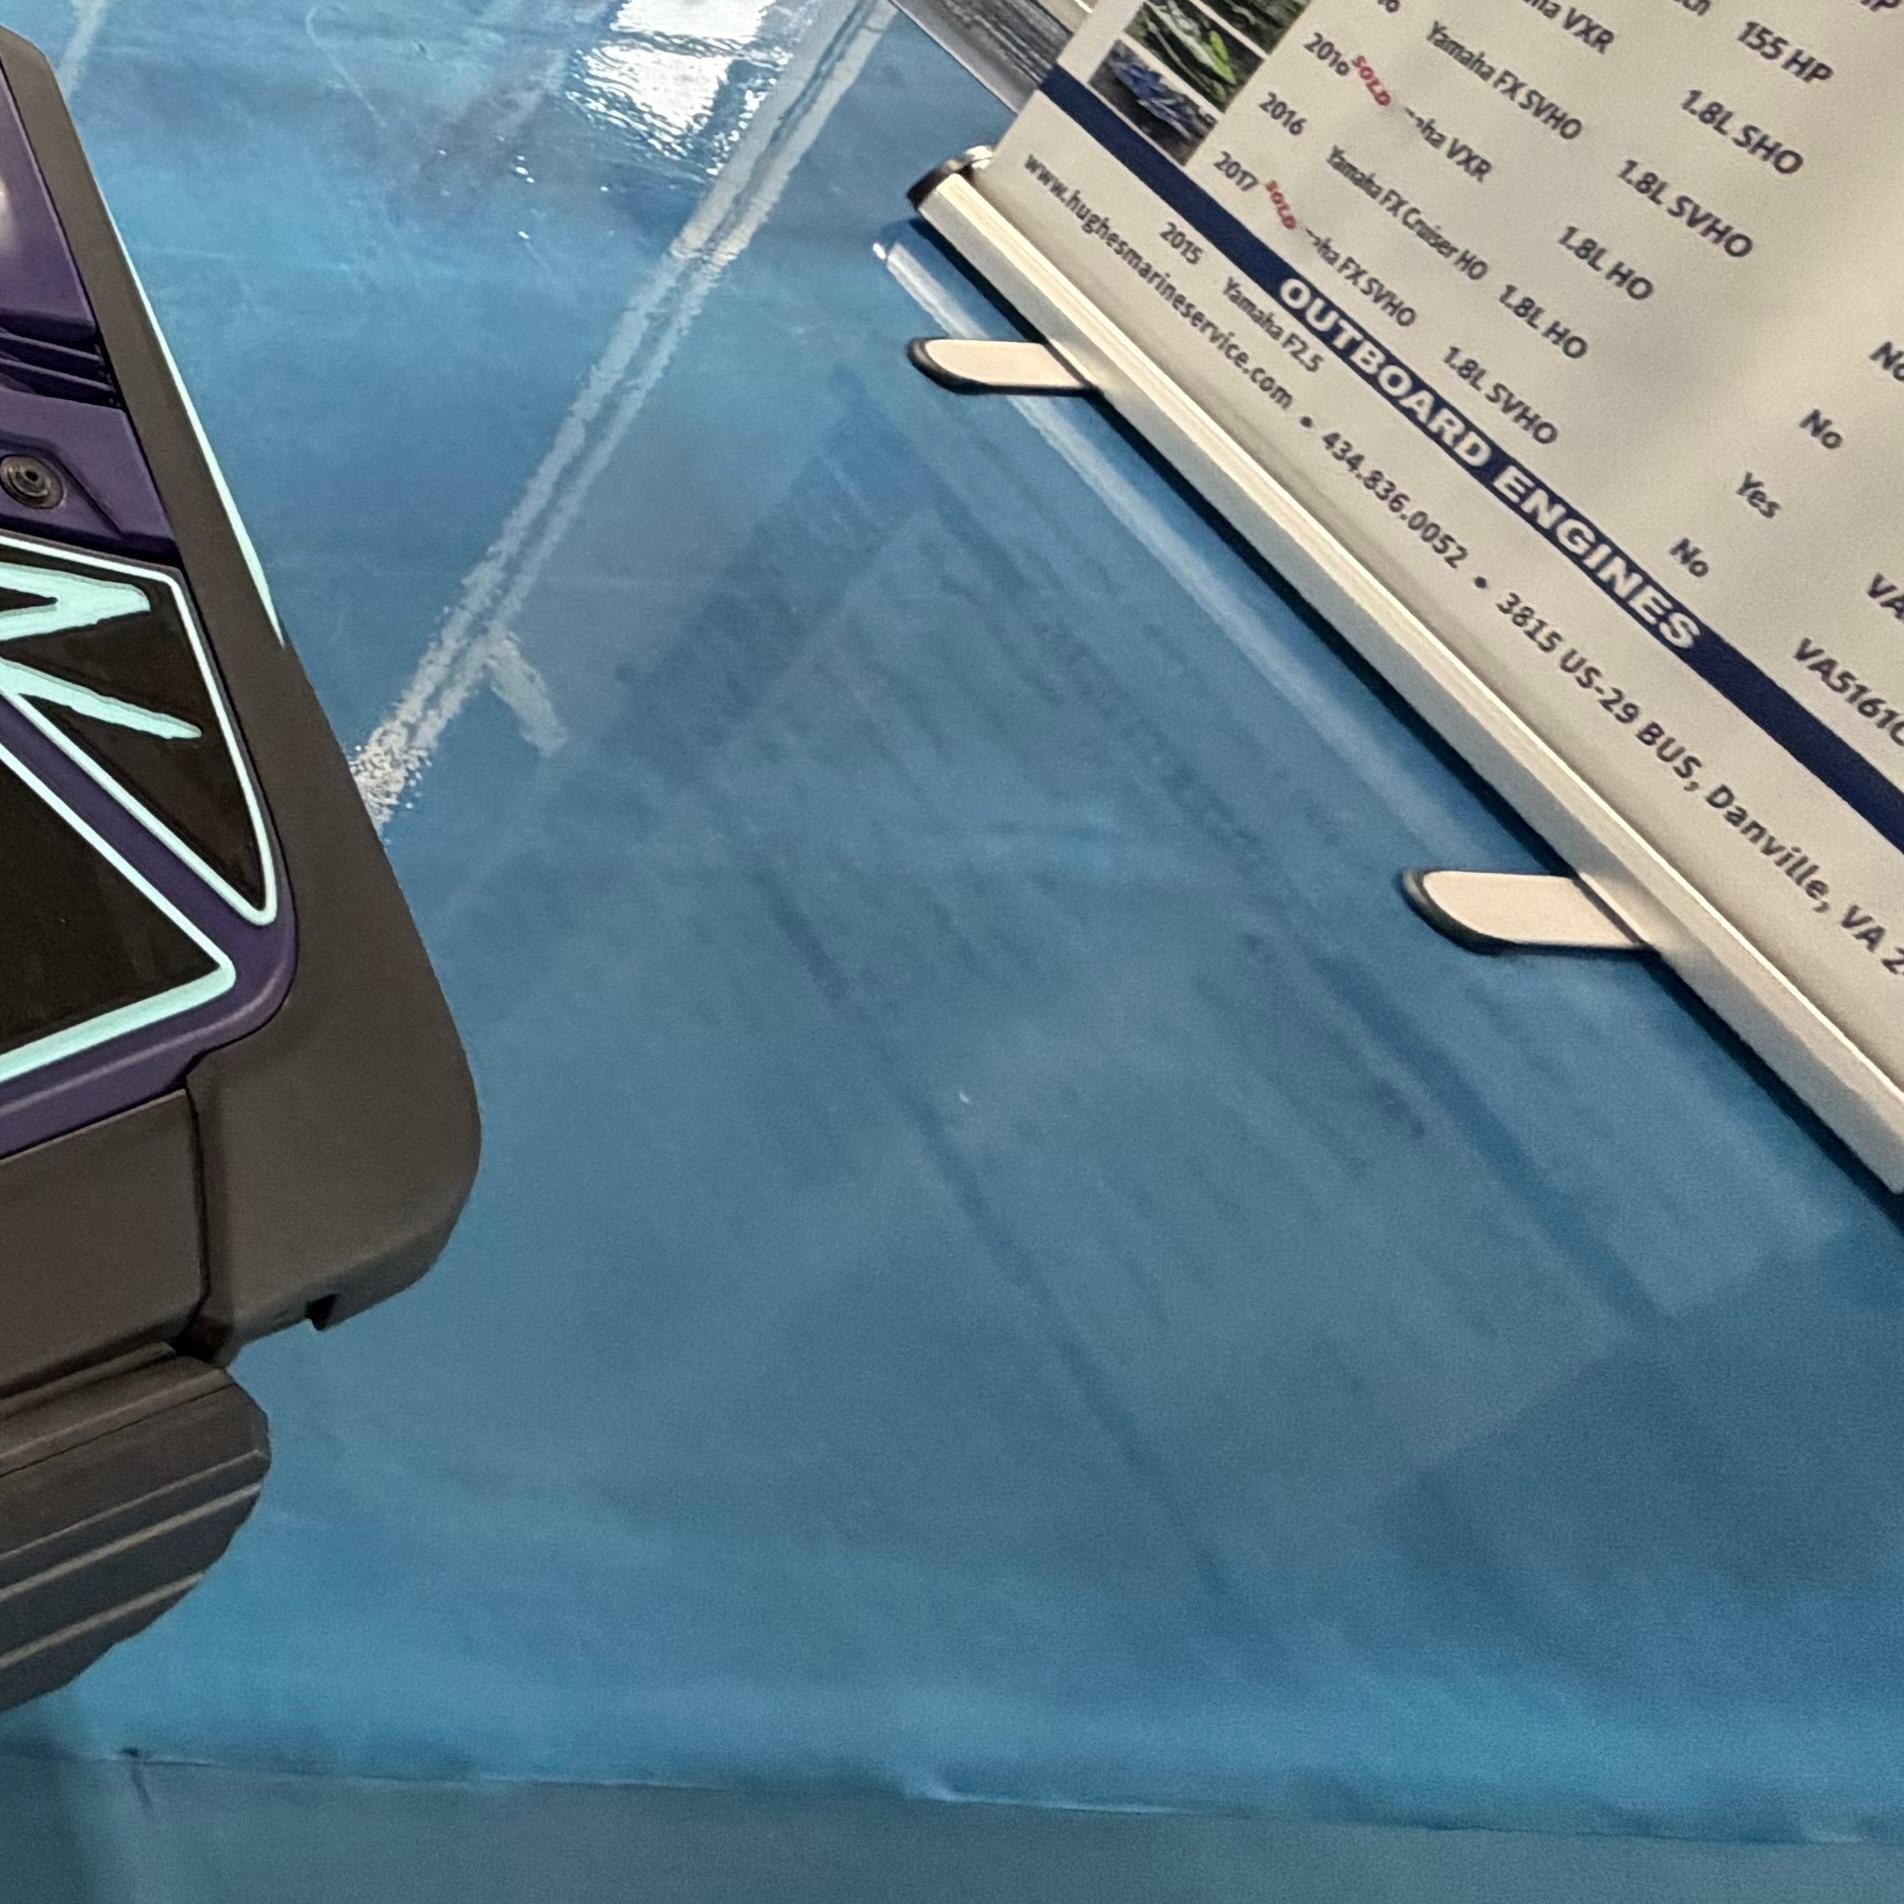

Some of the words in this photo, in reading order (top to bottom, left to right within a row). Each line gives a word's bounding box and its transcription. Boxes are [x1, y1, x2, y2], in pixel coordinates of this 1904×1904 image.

[1352, 54, 1392, 107] SOLD
[1562, 7, 1615, 55] VXR
[1681, 89, 1734, 137] 1.8L
[1732, 124, 1804, 176] SHO
[1737, 20, 1790, 60] 155
[1781, 48, 1834, 84] HP
[1213, 150, 1260, 193] 2017
[1265, 179, 1297, 231] SOLD
[1426, 20, 1496, 82] Yamaha
[1492, 69, 1528, 102] FX
[1518, 89, 1583, 141] SVHO
[1617, 158, 1670, 207] 1.8L
[1667, 194, 1754, 258] SVHO
[1159, 220, 1204, 266] 2015
[1221, 276, 1285, 342] Yamaha
[1282, 334, 1324, 374] F2.5
[1258, 91, 1309, 138] 2016
[1327, 145, 1383, 202] Yamaha
[1379, 189, 1409, 219] FX
[1401, 207, 1461, 260] Cruiser
[1455, 249, 1489, 282] HO
[1498, 283, 1546, 331] 1.8L
[1542, 319, 1589, 360] HO
[1446, 137, 1494, 184] VXR
[1558, 225, 1609, 273] 1.8L
[1604, 260, 1656, 303] HO
[1338, 256, 1368, 288] FX
[1361, 276, 1418, 328] SVHO
[1442, 345, 1489, 392] 1.8L
[1484, 382, 1559, 446] SVHO
[1279, 277, 1493, 469] OUTBOARD
[1493, 463, 1702, 652] ENGINES
[1735, 470, 1783, 520] Yes
[1798, 408, 1844, 451] No
[1023, 153, 1294, 411] www.hughesmarineservice.com
[1321, 430, 1471, 571] 434.836.0052
[1495, 591, 1564, 654] 3815
[1558, 647, 1641, 726] US-29
[1635, 721, 1704, 794] BUS,
[1704, 783, 1833, 915] Danville,
[1840, 904, 1888, 954] VA
[1668, 536, 1710, 579] No
